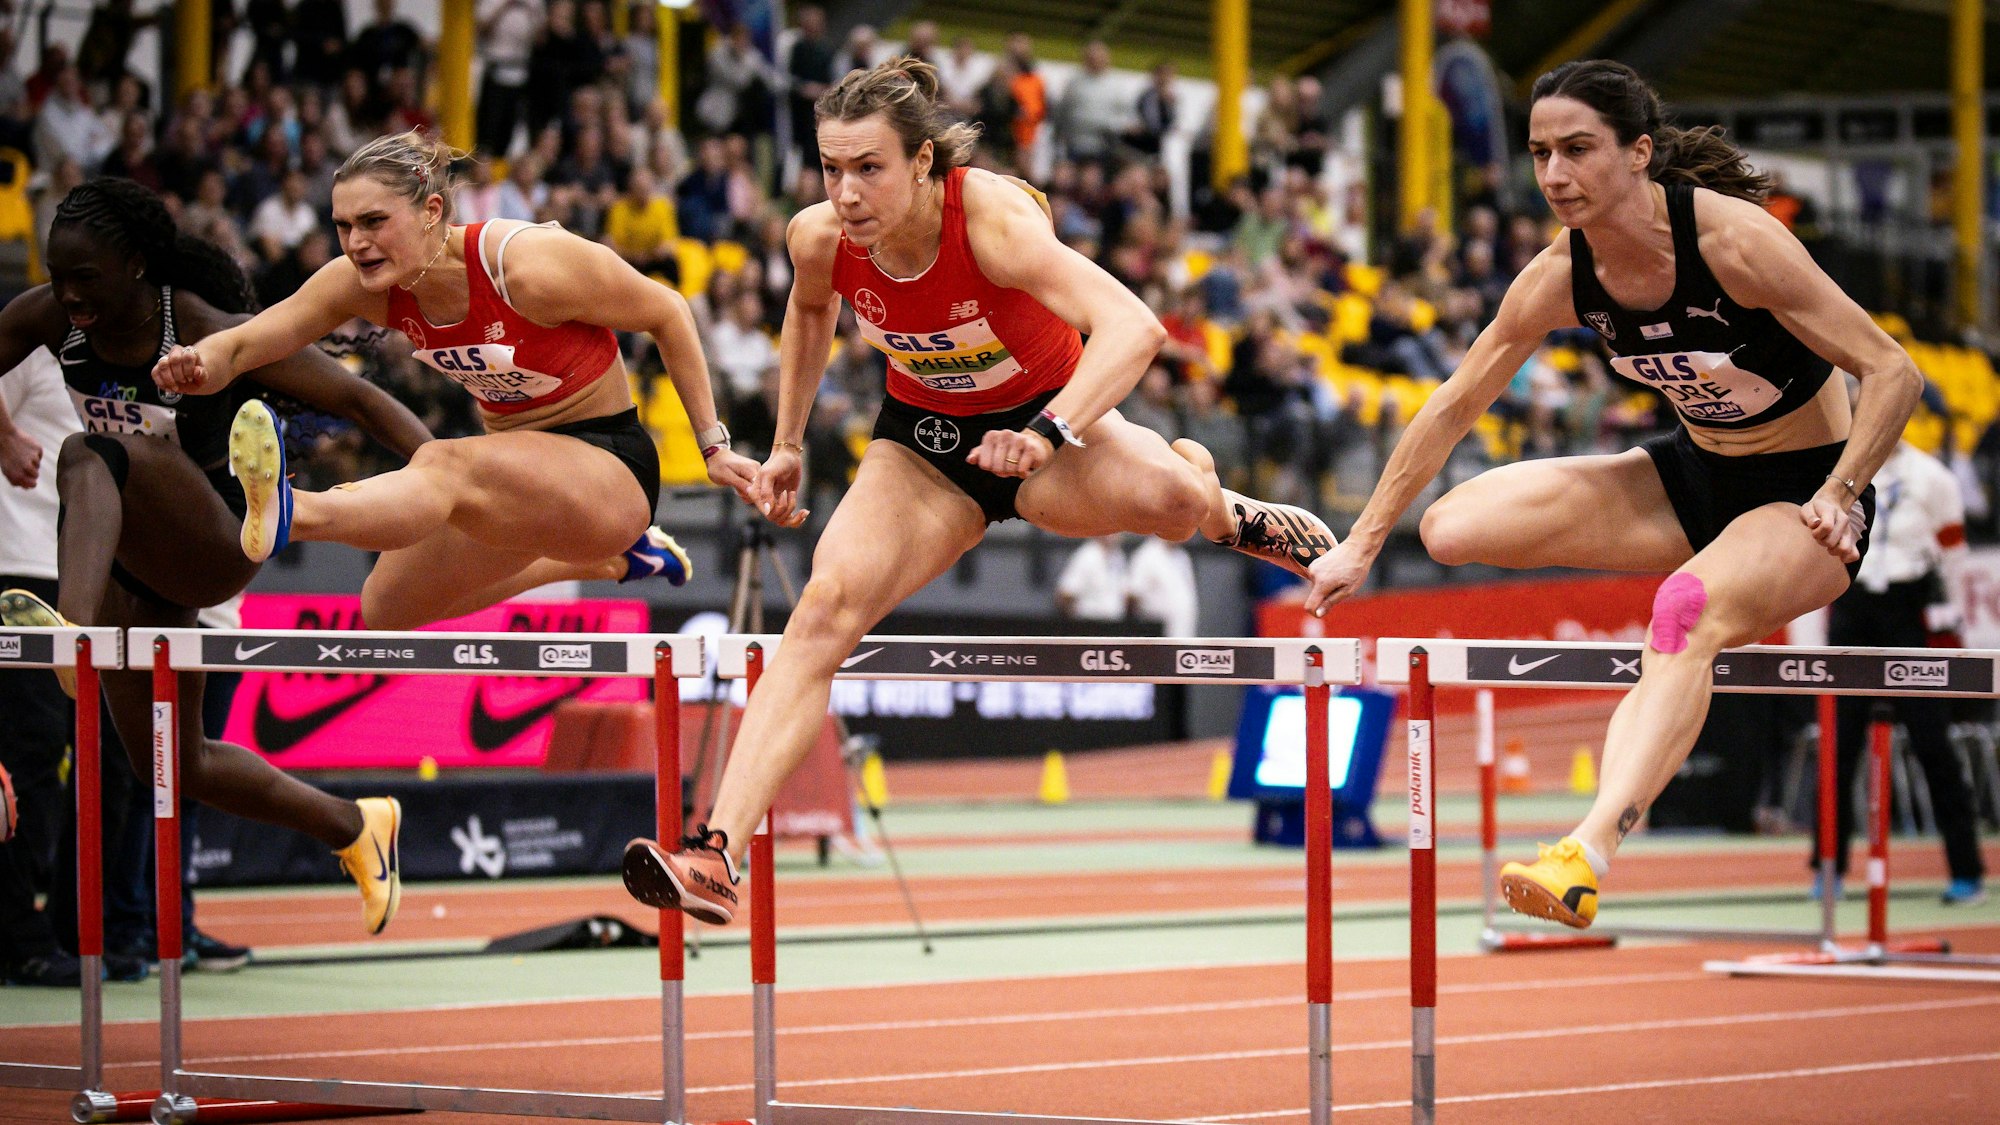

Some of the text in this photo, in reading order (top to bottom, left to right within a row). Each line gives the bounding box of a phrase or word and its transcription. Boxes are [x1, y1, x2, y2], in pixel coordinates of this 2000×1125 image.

[857, 300, 884, 314] BAYER
[910, 351, 997, 371] MEIER
[939, 376, 972, 387] PLAN
[1703, 403, 1739, 415] PLAN
[918, 428, 957, 440] BAYER
[933, 419, 942, 450] BAYER
[0, 640, 19, 650] LAN
[345, 648, 415, 659] XPENG
[453, 644, 499, 664] GLS.
[561, 649, 589, 659] PLAN
[960, 654, 1037, 665] XPENG
[1200, 654, 1231, 665] PLAN
[1080, 649, 1131, 671] GLS.
[1778, 659, 1834, 682] GLS.
[1911, 666, 1945, 676] PLAN
[154, 730, 168, 788] polanik
[1409, 752, 1425, 816] polanik
